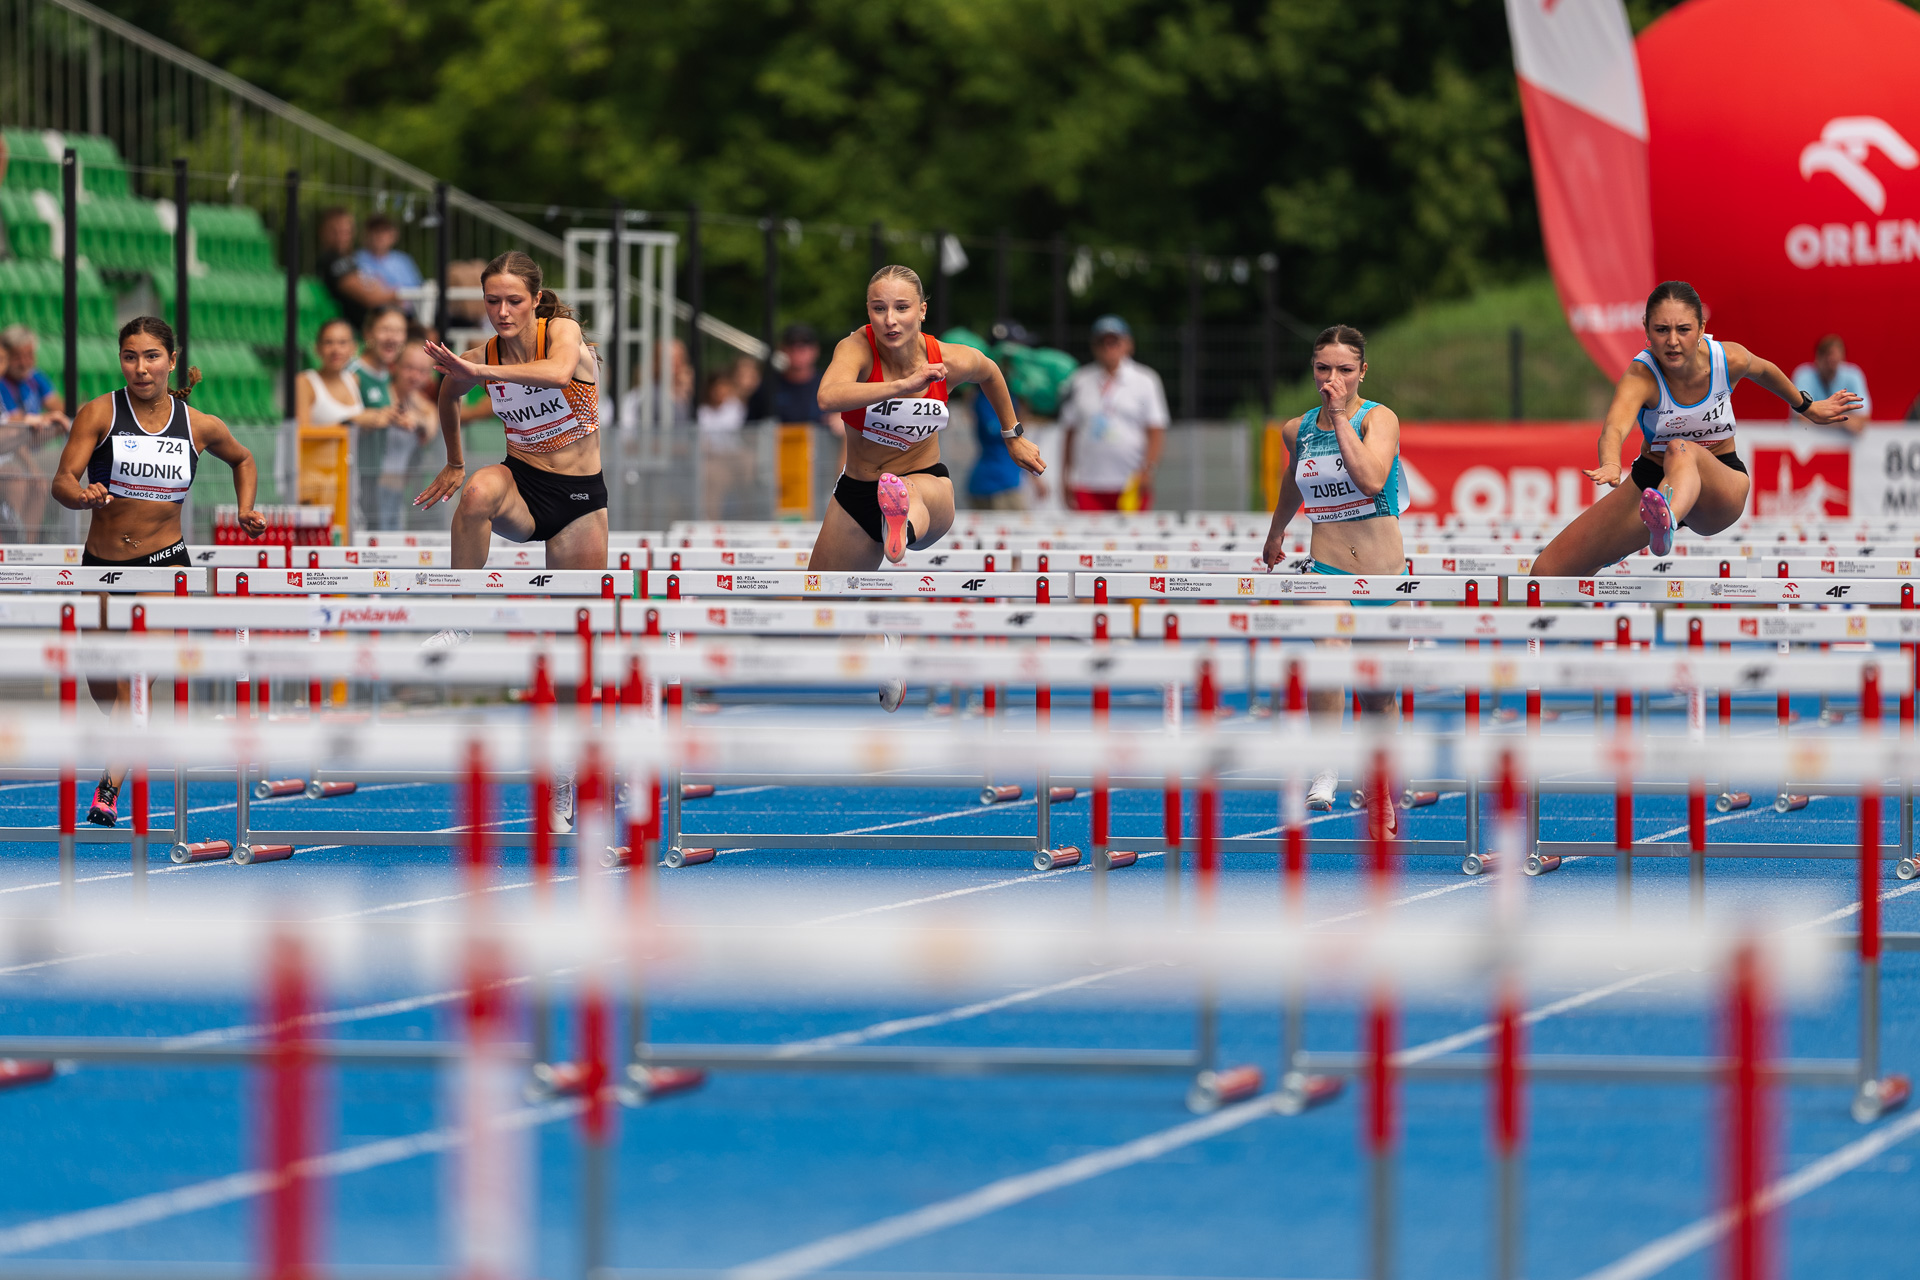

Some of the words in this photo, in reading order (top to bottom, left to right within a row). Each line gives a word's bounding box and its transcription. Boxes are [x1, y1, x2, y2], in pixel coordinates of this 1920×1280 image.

[522, 385, 551, 395] 32
[498, 398, 564, 424] PAWLAK
[912, 403, 941, 415] 218
[1702, 402, 1724, 422] 417
[546, 427, 562, 438] 2026
[872, 422, 939, 440] OLCZYK
[156, 441, 183, 454] 724
[120, 462, 182, 480] RUDNIK
[124, 490, 154, 499] ZAMOŚĆ
[1310, 481, 1356, 498] ZUBEL
[1317, 511, 1342, 520] ZAMOŚĆ
[149, 549, 172, 564] NIKE
[172, 542, 184, 555] PRO
[339, 606, 408, 628] polanik
